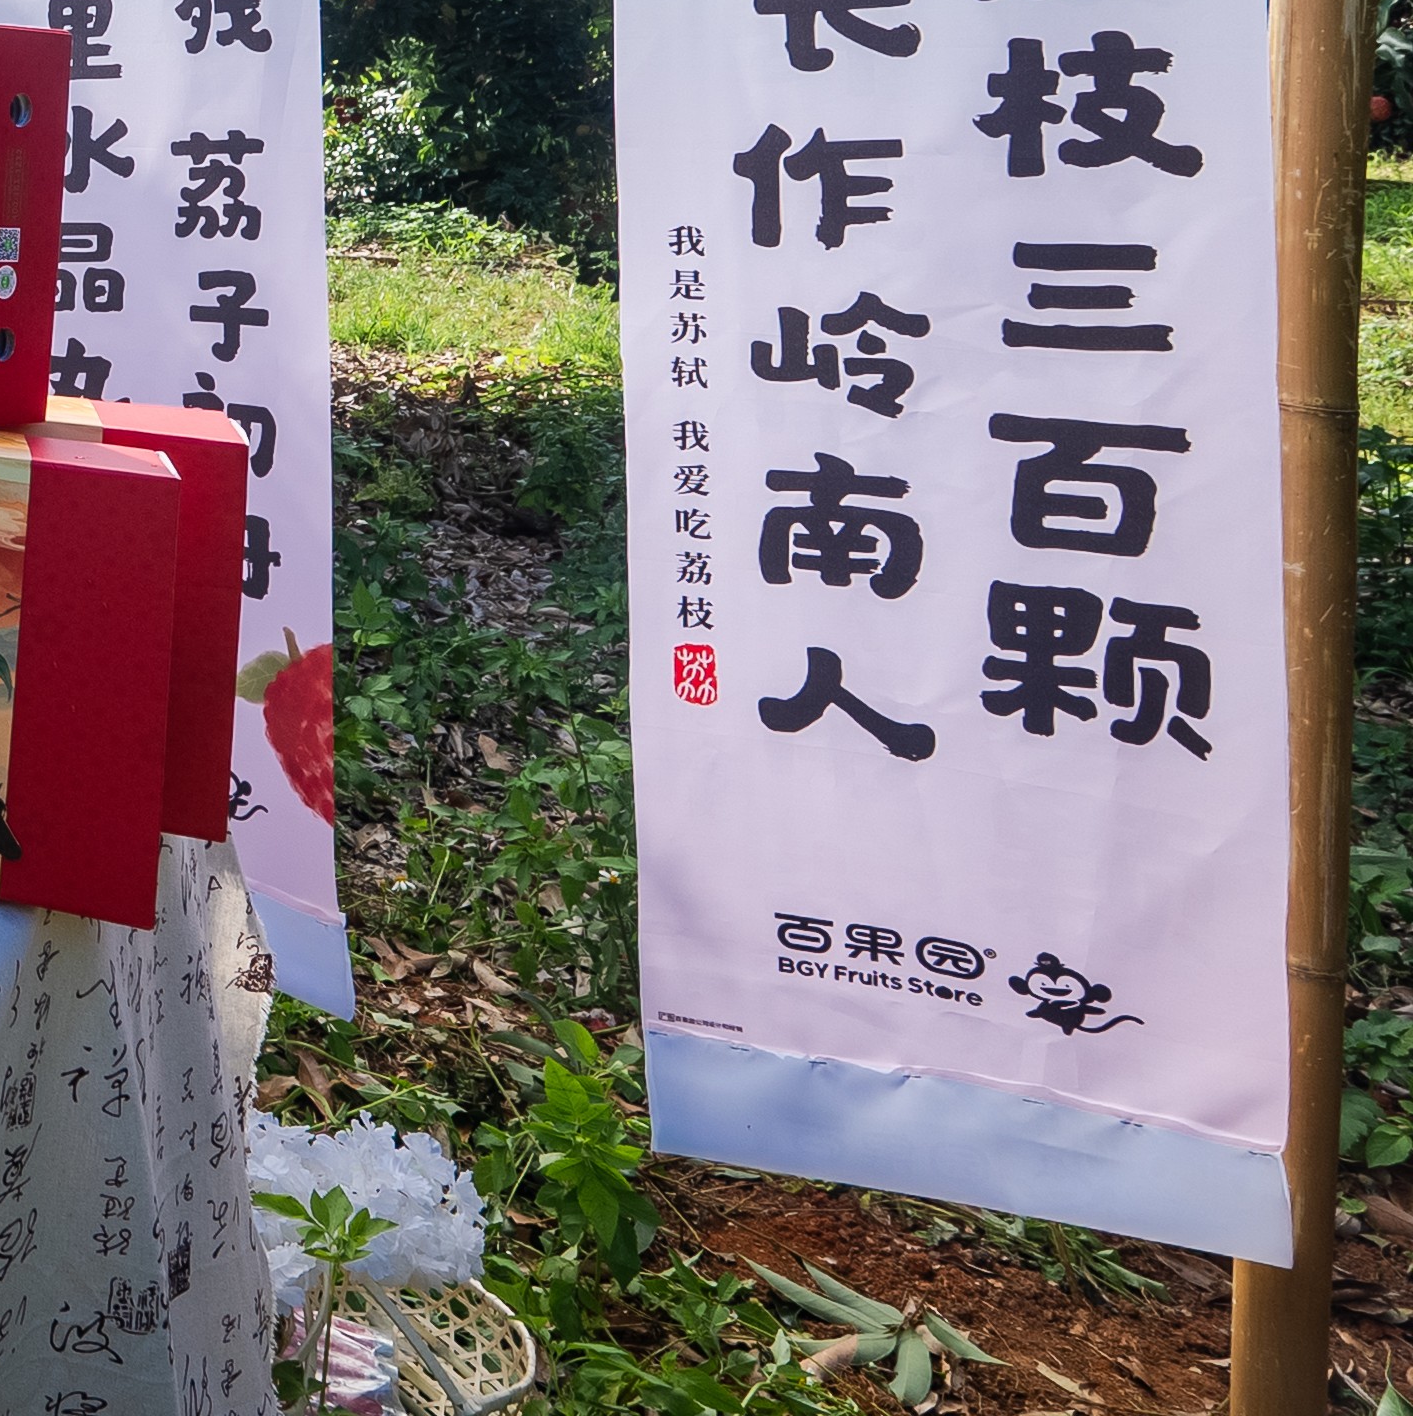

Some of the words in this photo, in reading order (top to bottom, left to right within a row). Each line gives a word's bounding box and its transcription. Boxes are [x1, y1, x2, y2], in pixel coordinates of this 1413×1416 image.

[667, 225, 708, 389] 我是苏轼
[672, 419, 715, 631] 我爱吃荔枝
[774, 912, 986, 981] 百果园
[777, 956, 828, 979] BGY
[833, 965, 903, 991] Fruits
[908, 976, 984, 1008] Store
